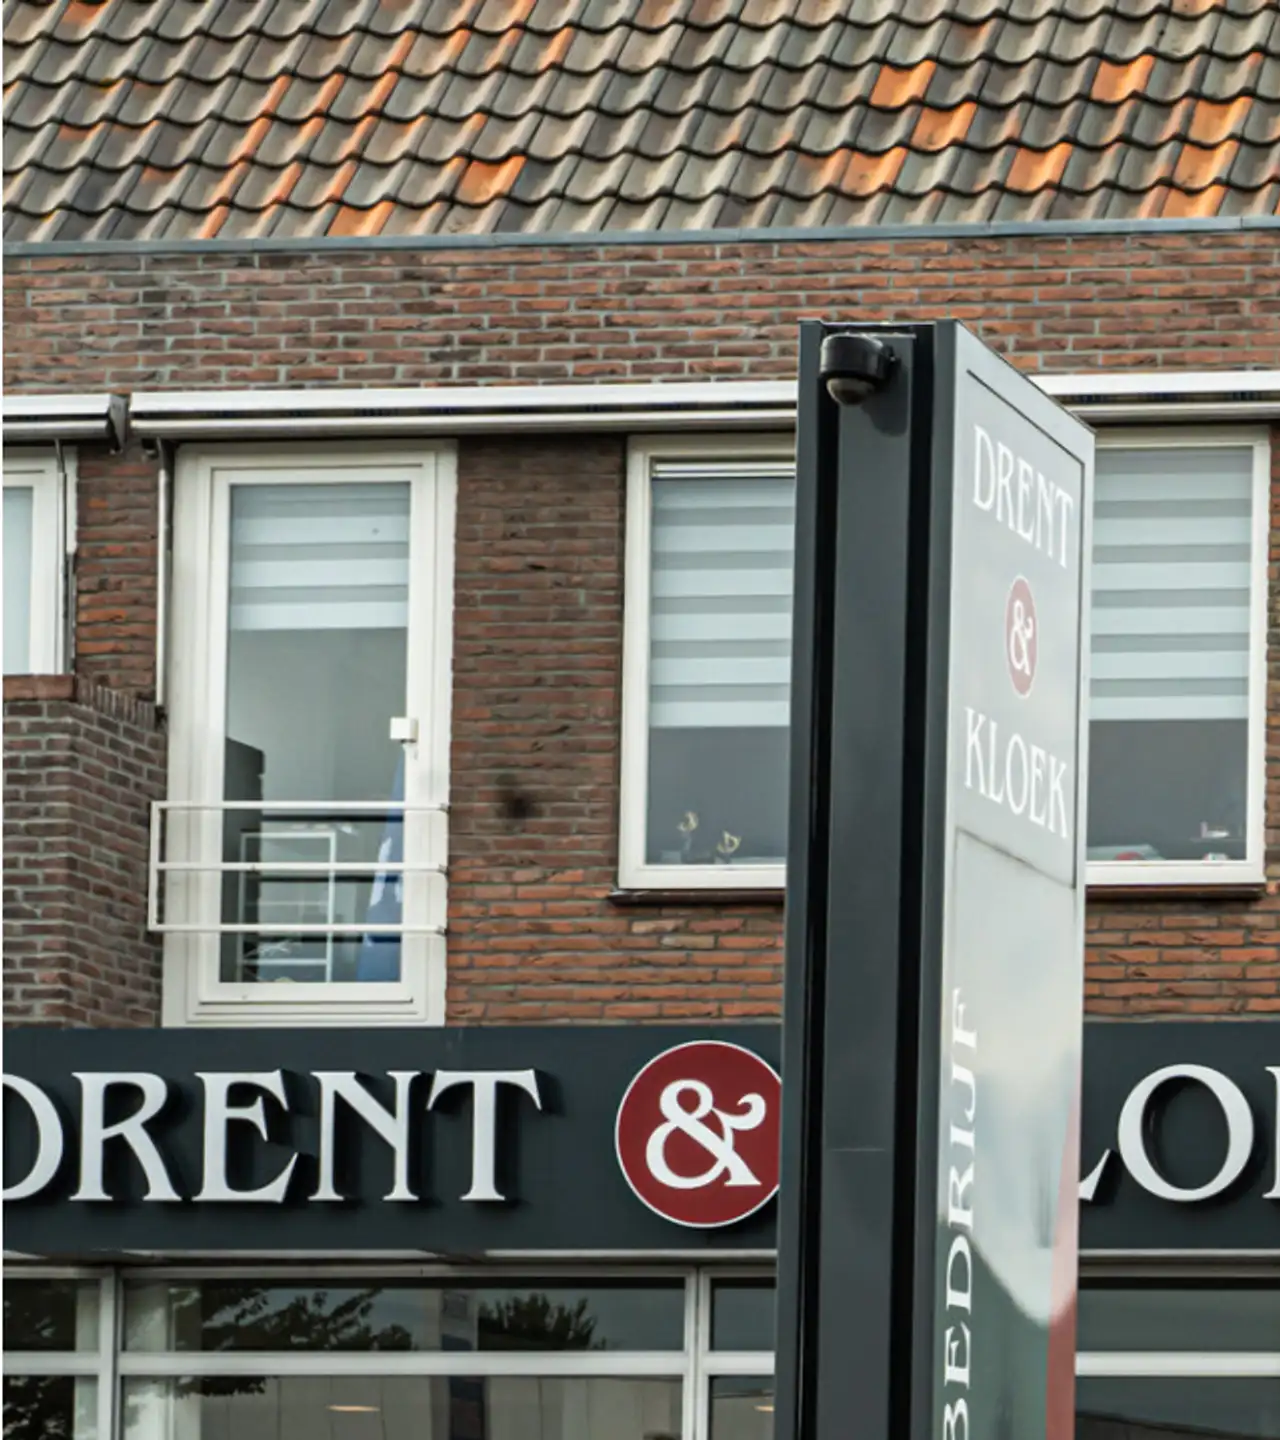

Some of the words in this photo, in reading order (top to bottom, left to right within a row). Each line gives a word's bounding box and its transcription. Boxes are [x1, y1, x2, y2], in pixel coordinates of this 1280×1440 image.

[973, 423, 1073, 569] DRENT
[1009, 599, 1034, 676] &
[963, 705, 1068, 838] KLOEK
[645, 1077, 767, 1190] &
